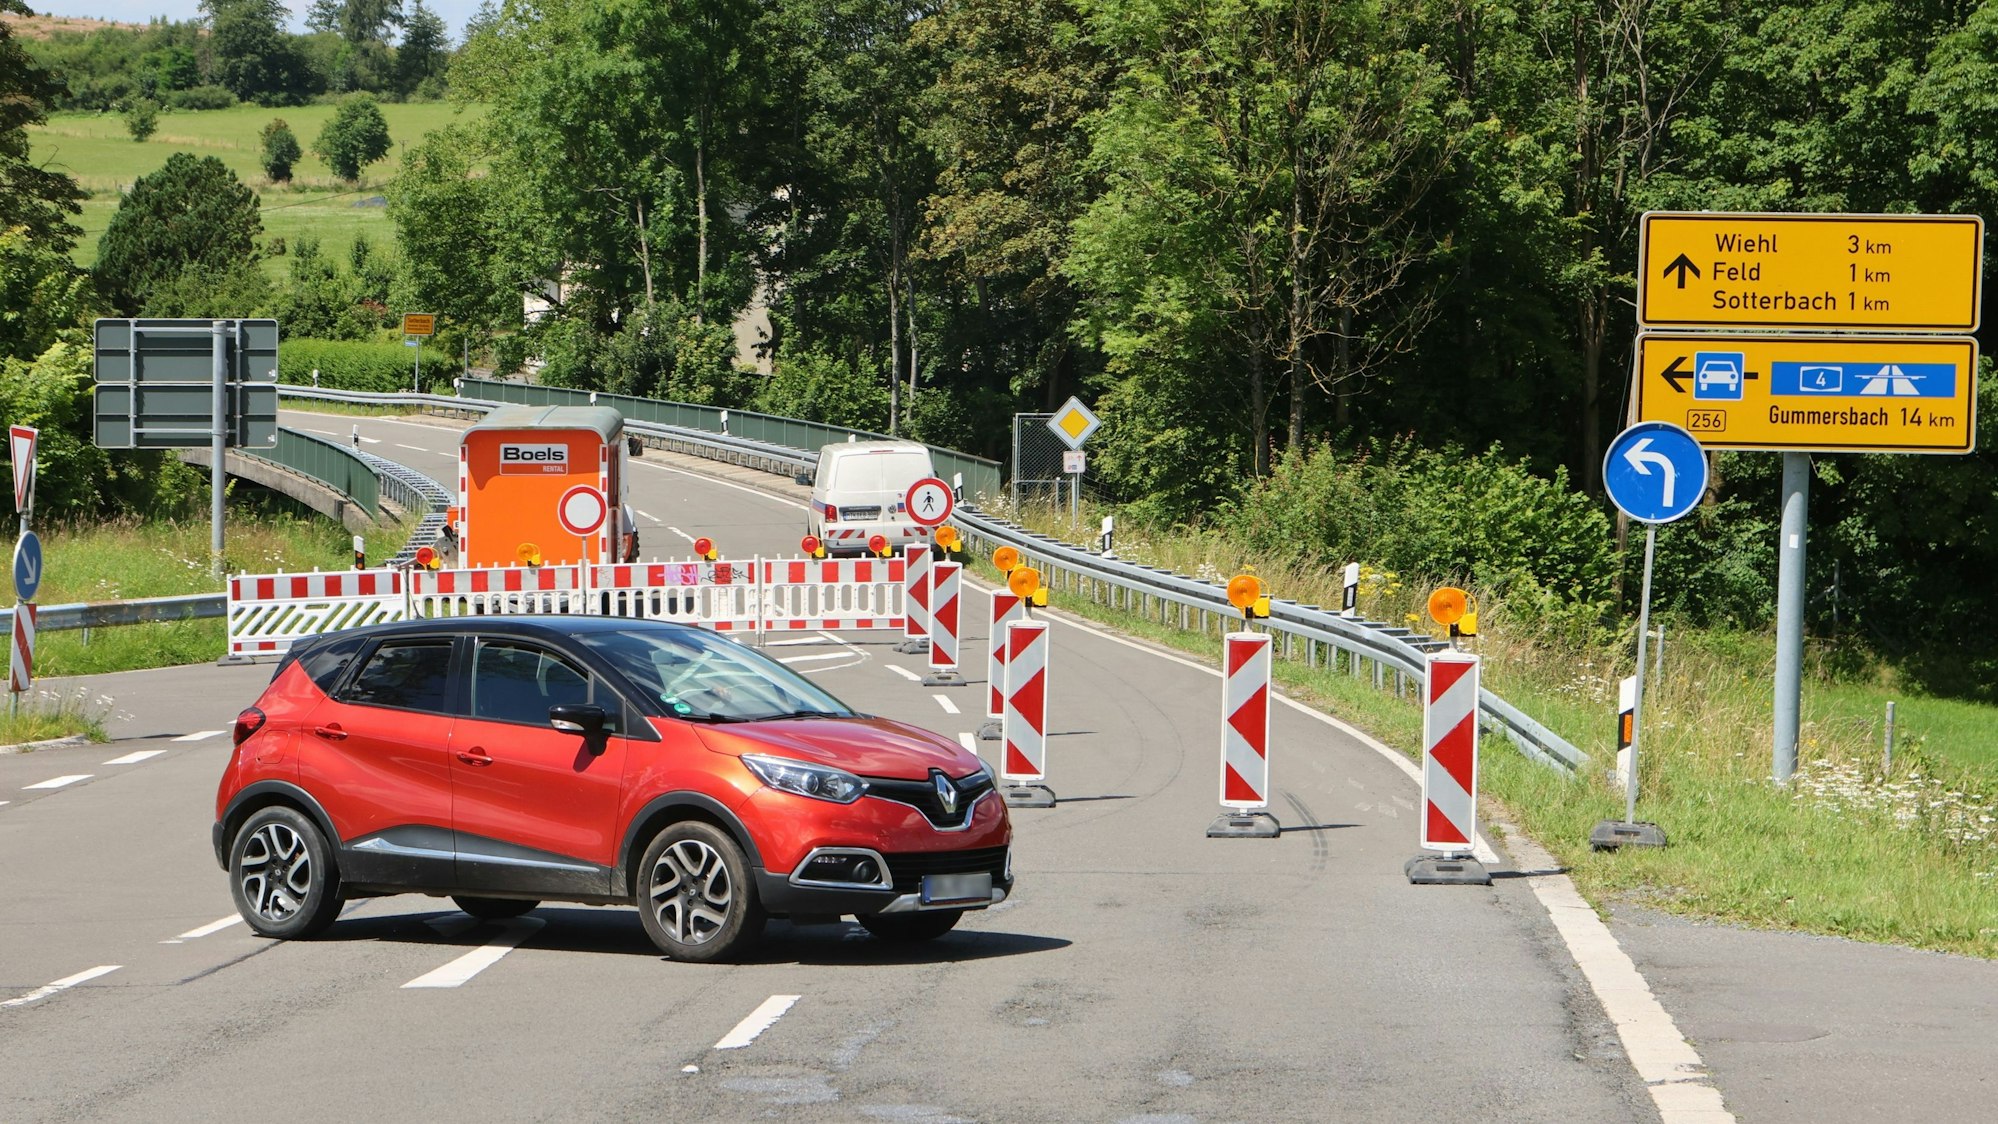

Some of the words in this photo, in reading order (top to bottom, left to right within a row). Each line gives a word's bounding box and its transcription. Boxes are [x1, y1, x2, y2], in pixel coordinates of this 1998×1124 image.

[1715, 233, 1778, 253] Wiehl
[1847, 234, 1860, 254] 3
[1865, 239, 1892, 254] km
[1712, 262, 1761, 281] Feld
[1849, 263, 1856, 282] 1
[1864, 268, 1891, 282] km
[1712, 290, 1837, 310] Sotterbach
[1848, 291, 1856, 311] 1
[1863, 296, 1890, 311] km
[1815, 371, 1827, 387] 4
[1691, 413, 1722, 428] 256
[1768, 405, 1889, 426] Gummersbach
[1900, 408, 1923, 427] 14
[1928, 414, 1955, 428] km
[503, 447, 565, 461] Boels
[542, 465, 565, 473] RENTAL
